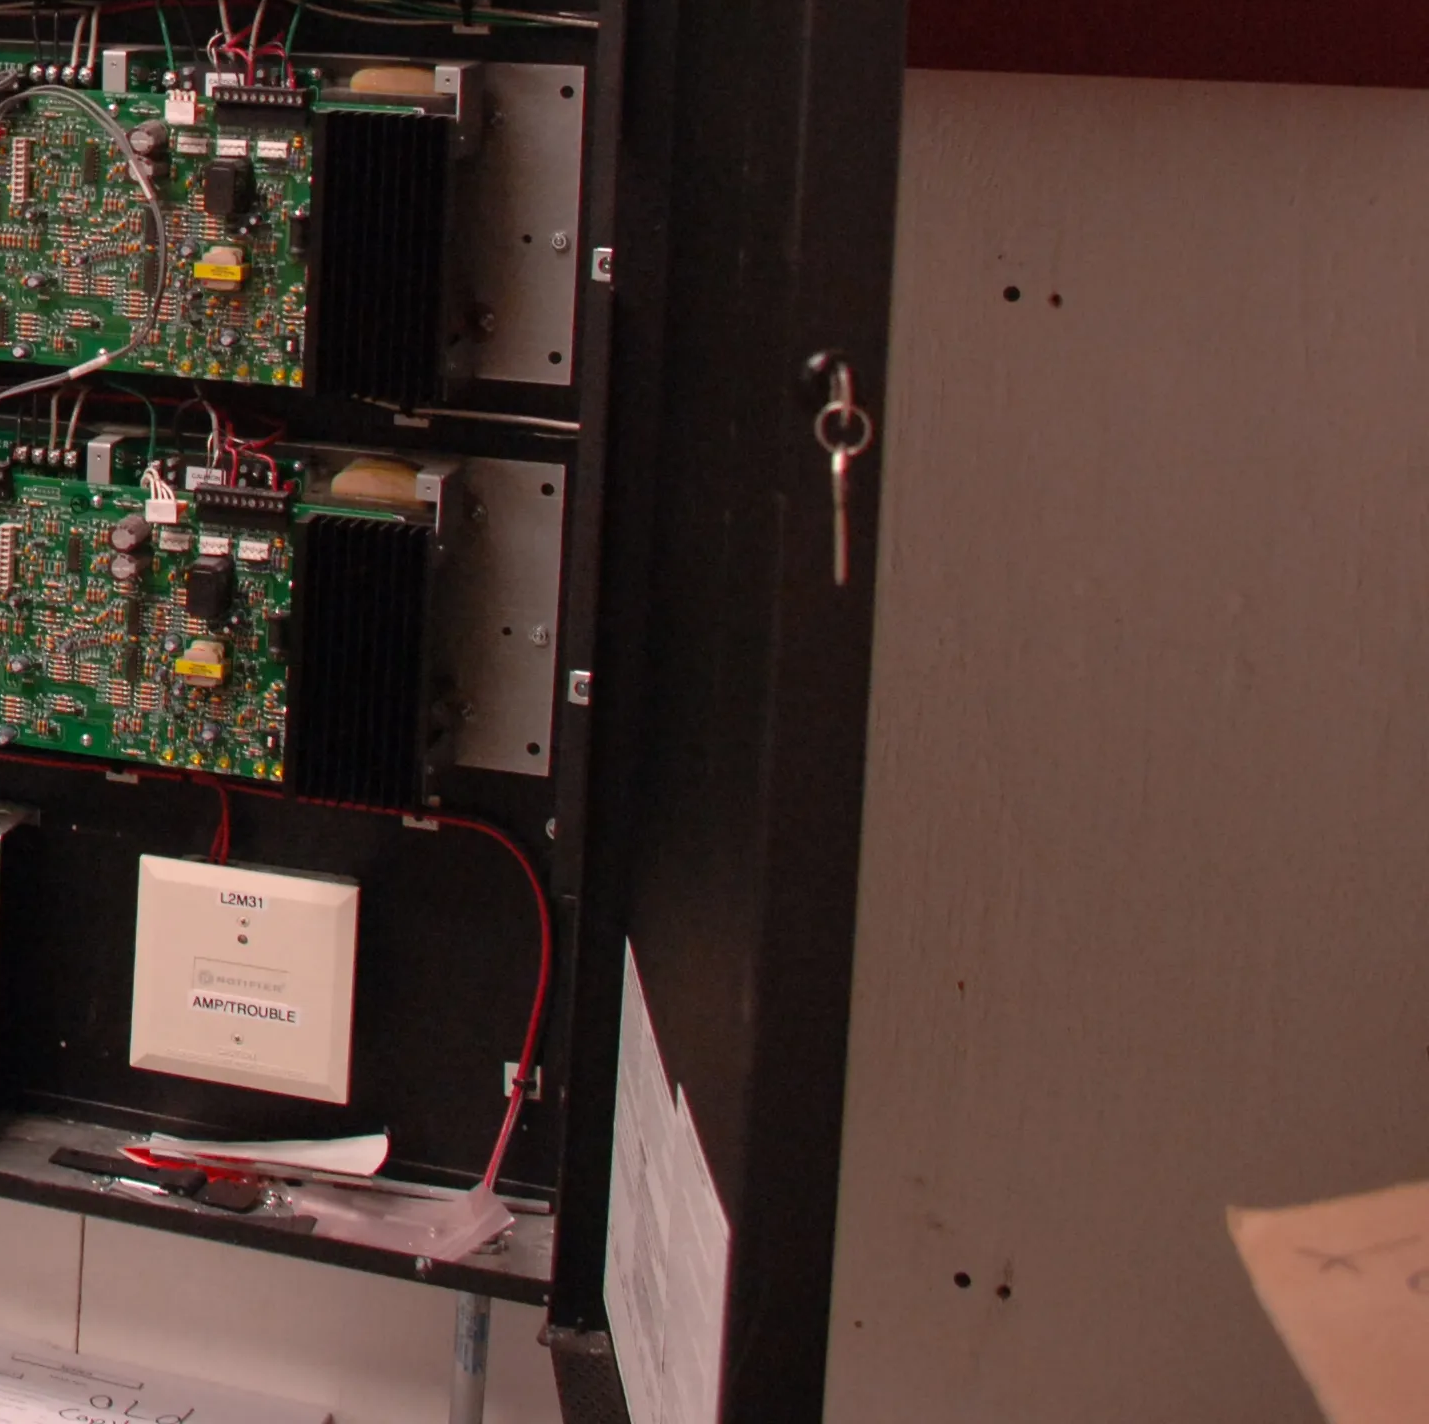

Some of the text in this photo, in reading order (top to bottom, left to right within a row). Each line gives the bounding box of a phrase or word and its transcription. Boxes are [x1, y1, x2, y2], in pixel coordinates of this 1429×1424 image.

[220, 892, 264, 909] L2M31
[216, 975, 287, 993] NOTIFIER
[193, 995, 296, 1023] AMP/TROUBLE
